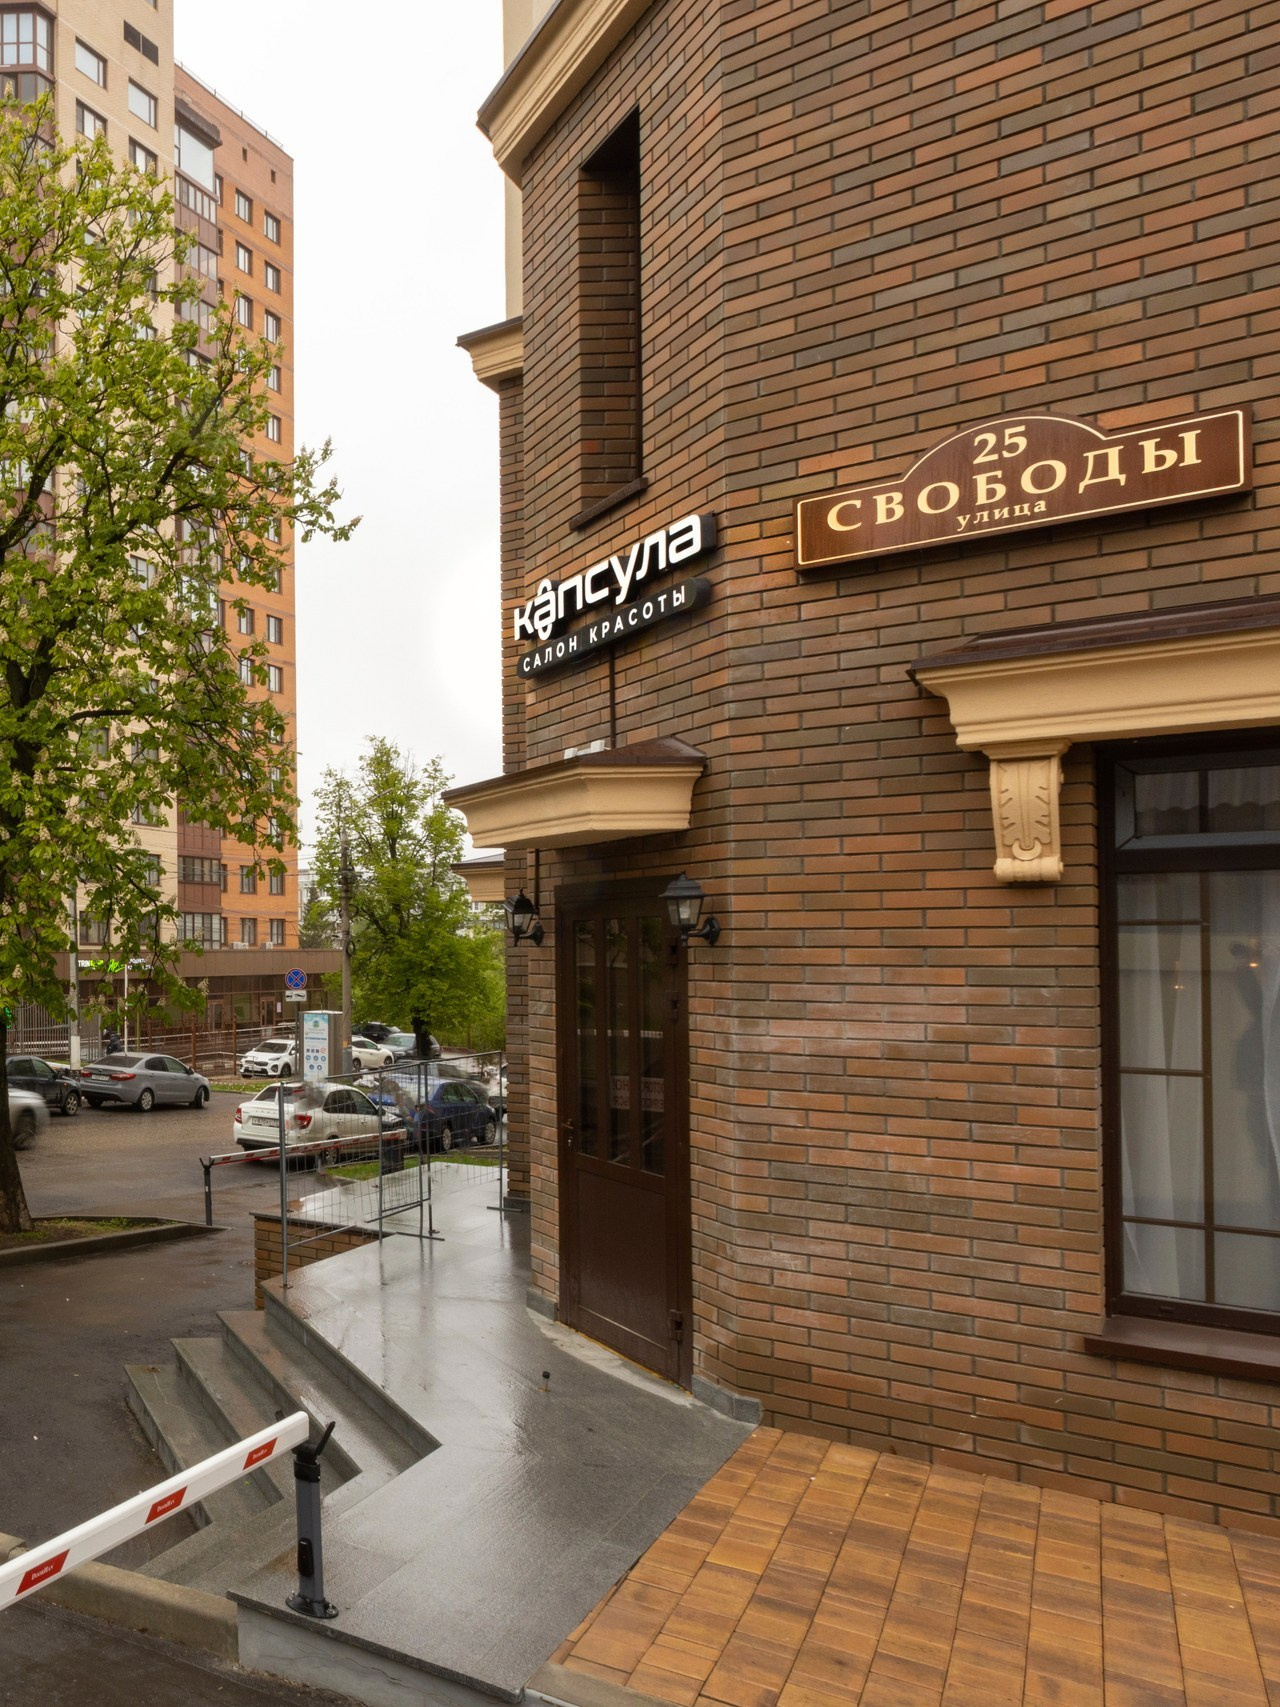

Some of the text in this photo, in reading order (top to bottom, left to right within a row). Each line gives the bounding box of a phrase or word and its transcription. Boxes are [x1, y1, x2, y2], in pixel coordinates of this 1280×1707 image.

[973, 425, 1028, 464] 25
[827, 430, 1202, 532] СВОБОДЫ
[956, 500, 1047, 531] улица
[523, 585, 685, 672] САЛОН КРАСОТЫ
